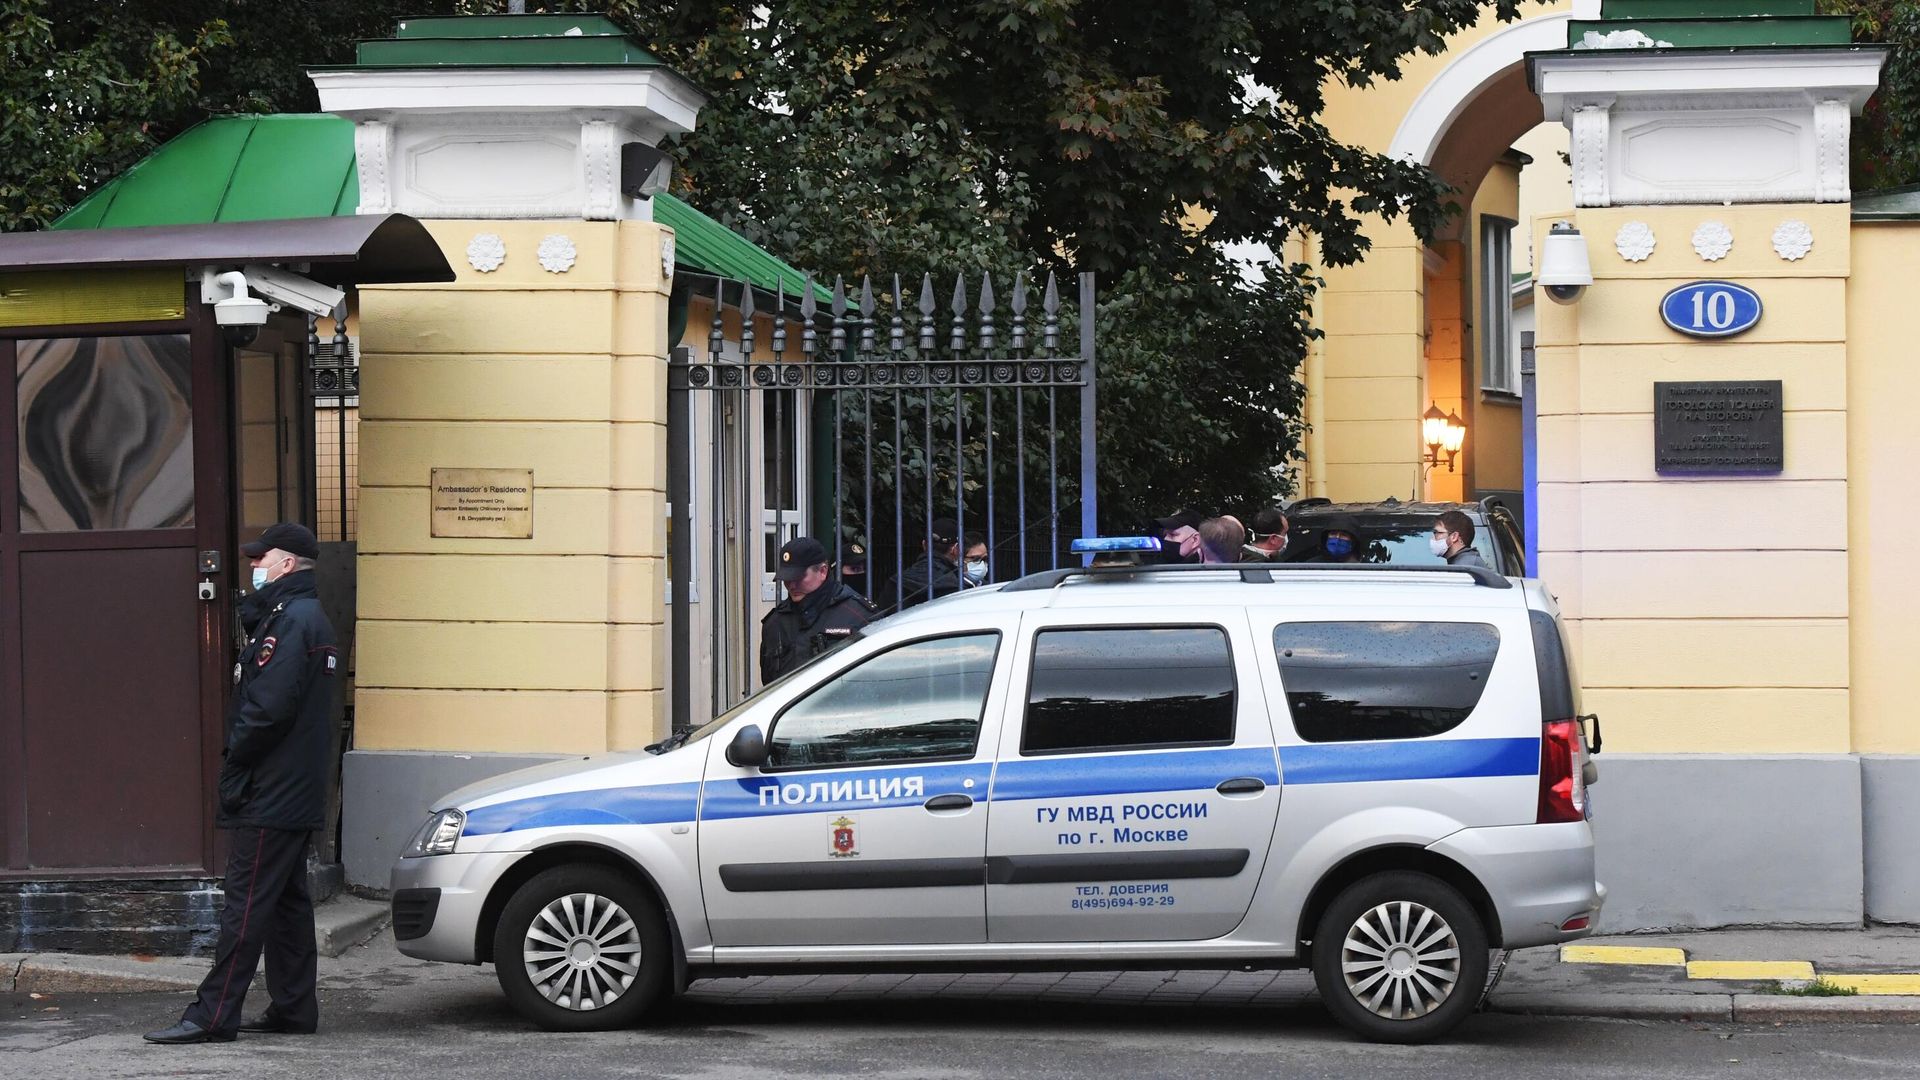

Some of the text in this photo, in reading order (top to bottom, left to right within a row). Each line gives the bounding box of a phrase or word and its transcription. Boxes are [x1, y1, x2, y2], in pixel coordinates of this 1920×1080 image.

[1691, 291, 1735, 328] 10
[1664, 400, 1725, 411] ГОРОДСКАЯ
[1705, 411, 1754, 421] ВТОРОВА
[489, 485, 527, 493] Residence
[759, 776, 923, 806] ПОЛИЦИЯ
[1037, 803, 1207, 824] ГУ МВД РОССИИ
[1058, 827, 1189, 845] по г. Москве
[1076, 883, 1169, 896] ТЕЛ. ДОВЕРИЯ
[1071, 896, 1175, 910] 8(495)694-92-29
